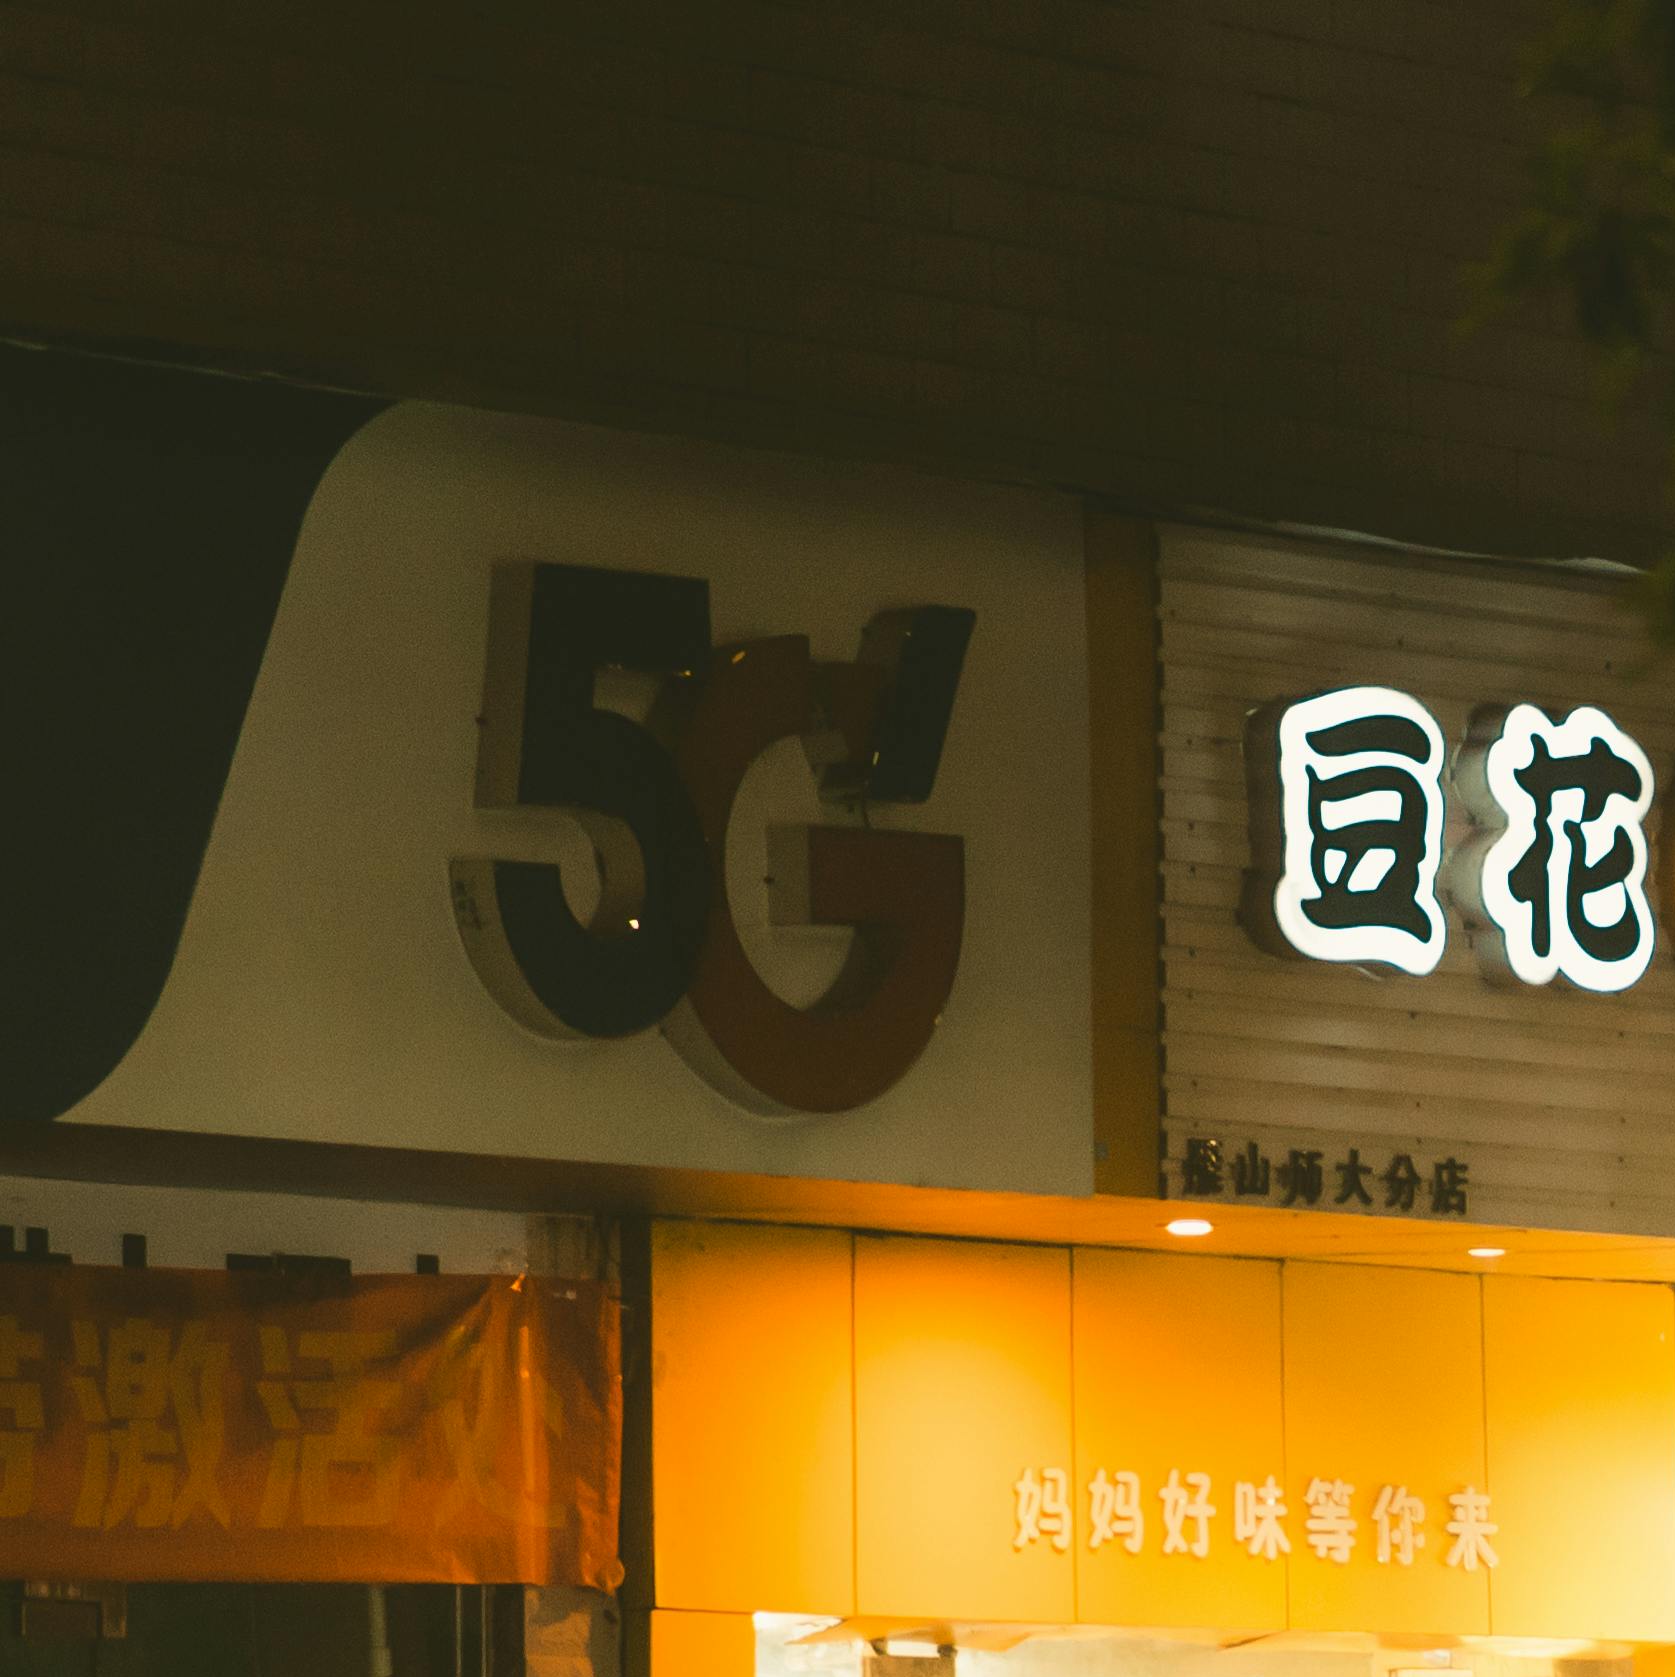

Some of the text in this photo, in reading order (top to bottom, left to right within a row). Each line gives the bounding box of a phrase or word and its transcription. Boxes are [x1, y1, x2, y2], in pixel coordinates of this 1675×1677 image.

[449, 560, 975, 1114] 5G
[1270, 684, 1659, 994] 豆花
[1011, 1465, 1501, 1573] 妈妈好味等你来
